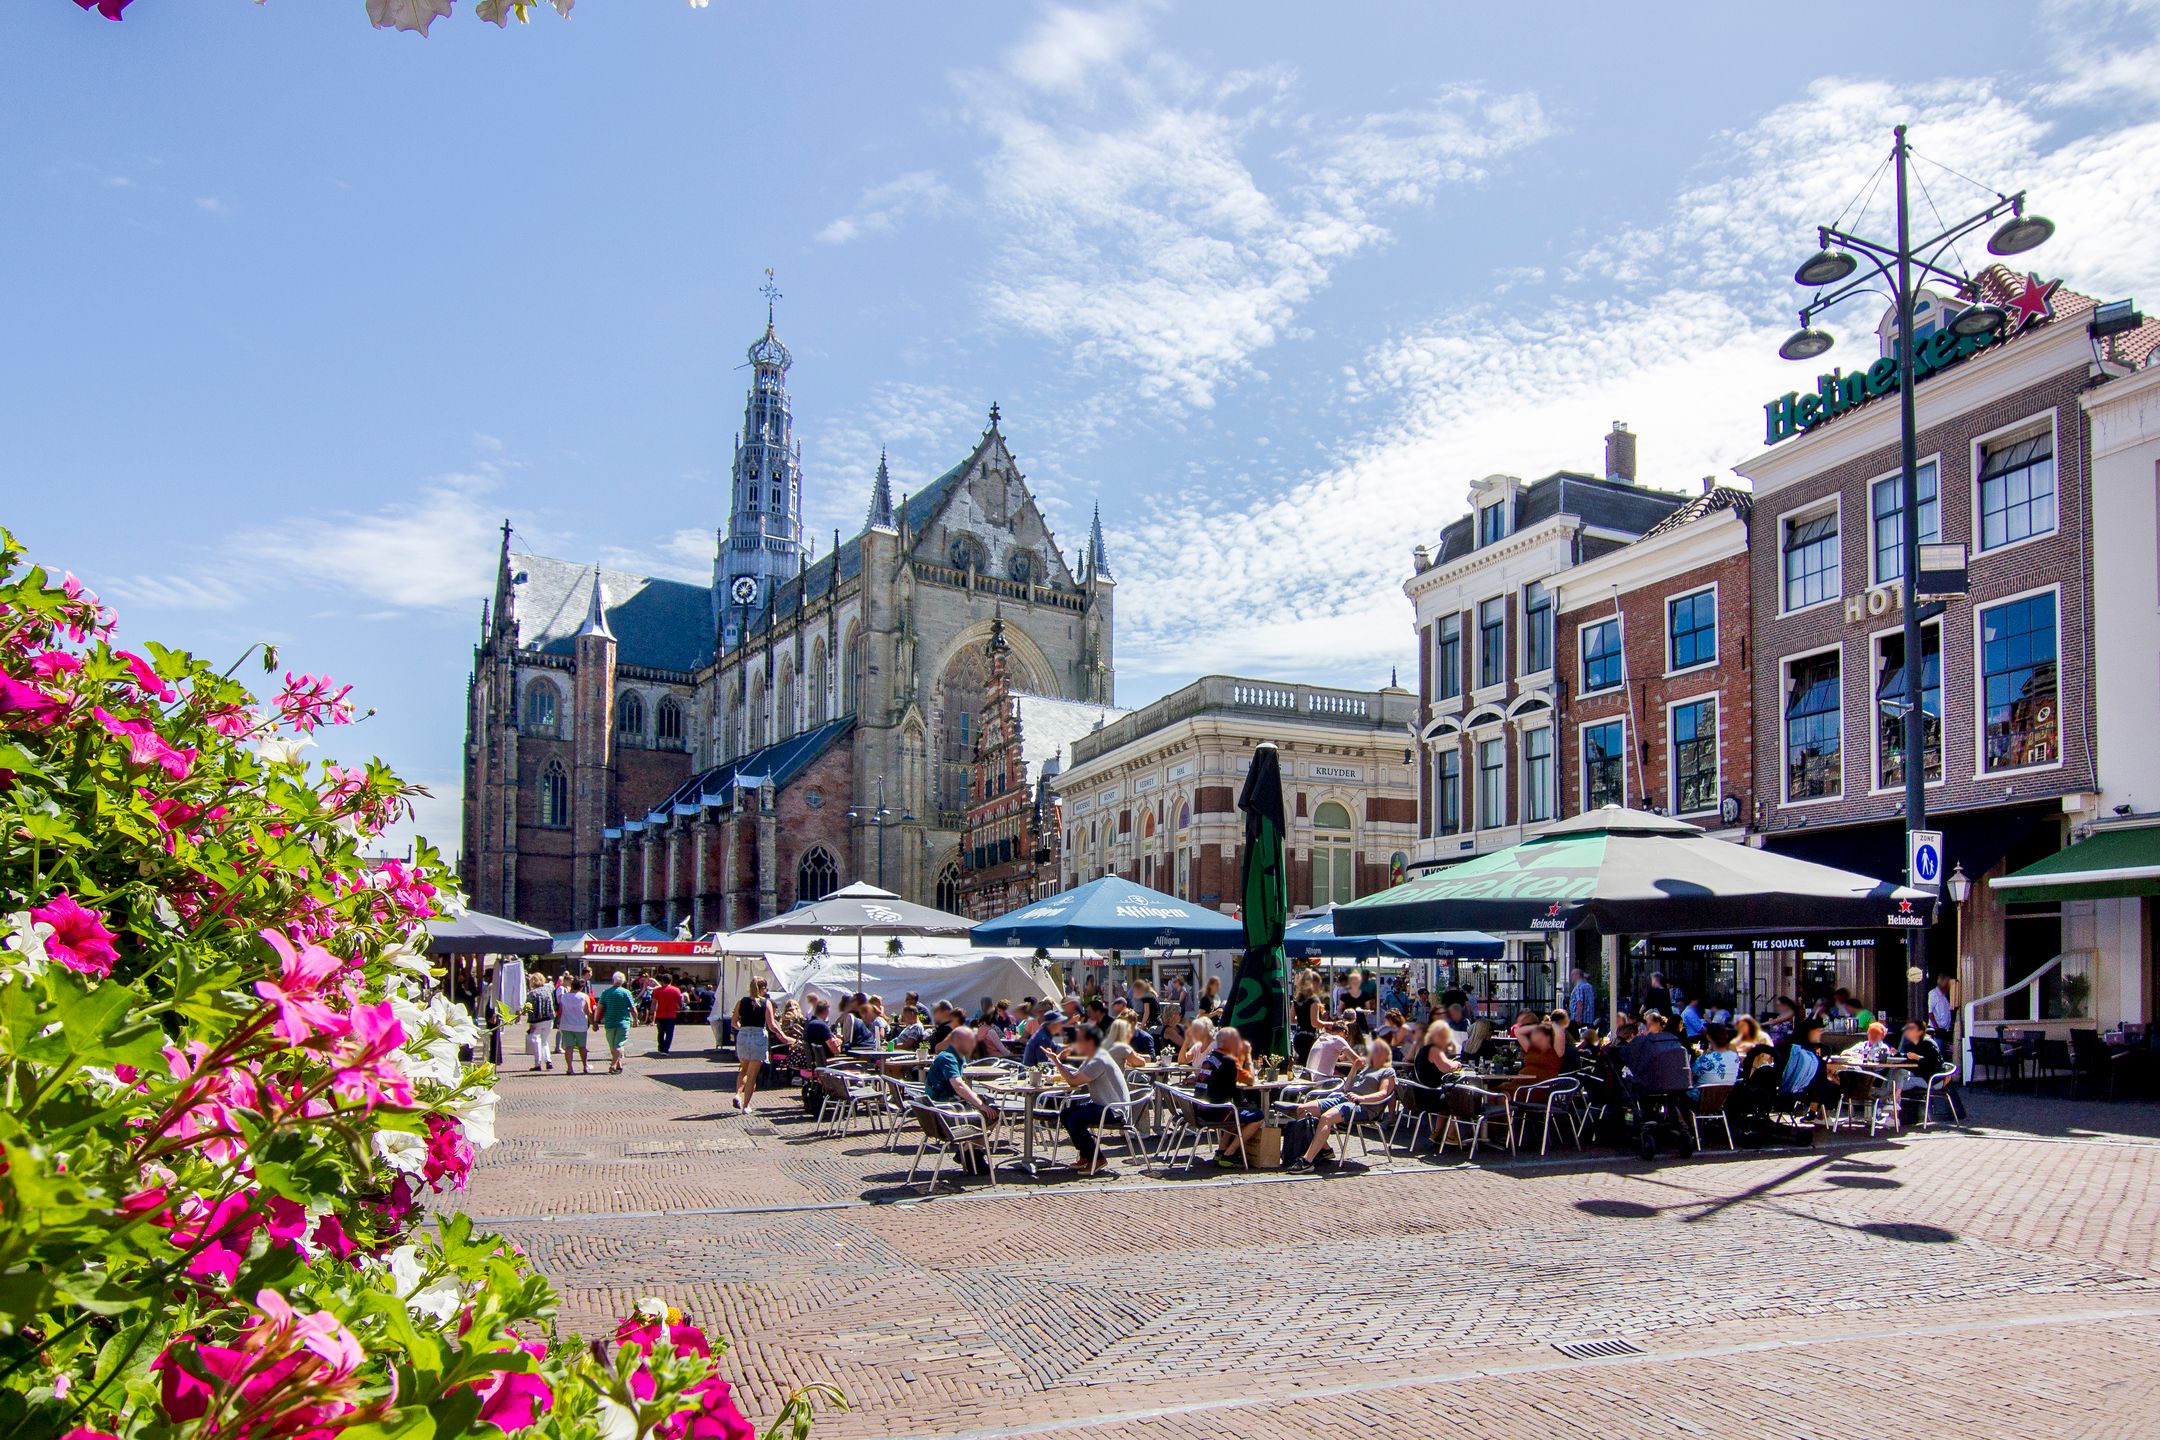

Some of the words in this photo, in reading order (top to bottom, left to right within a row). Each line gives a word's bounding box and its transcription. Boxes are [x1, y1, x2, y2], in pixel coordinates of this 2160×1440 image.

[1315, 766, 1356, 778] KRUYDER
[1919, 834, 1935, 843] ZONE
[1115, 905, 1190, 919] Affligem
[1529, 917, 1567, 929] Heineken
[1887, 914, 1924, 926] Heineken
[1154, 936, 1180, 947] Affligem
[1752, 940, 1768, 949] THE
[1770, 938, 1805, 949] SQUARE
[1852, 938, 1875, 946] DRINKS
[591, 943, 628, 953] Türkse
[630, 944, 658, 953] Pizza
